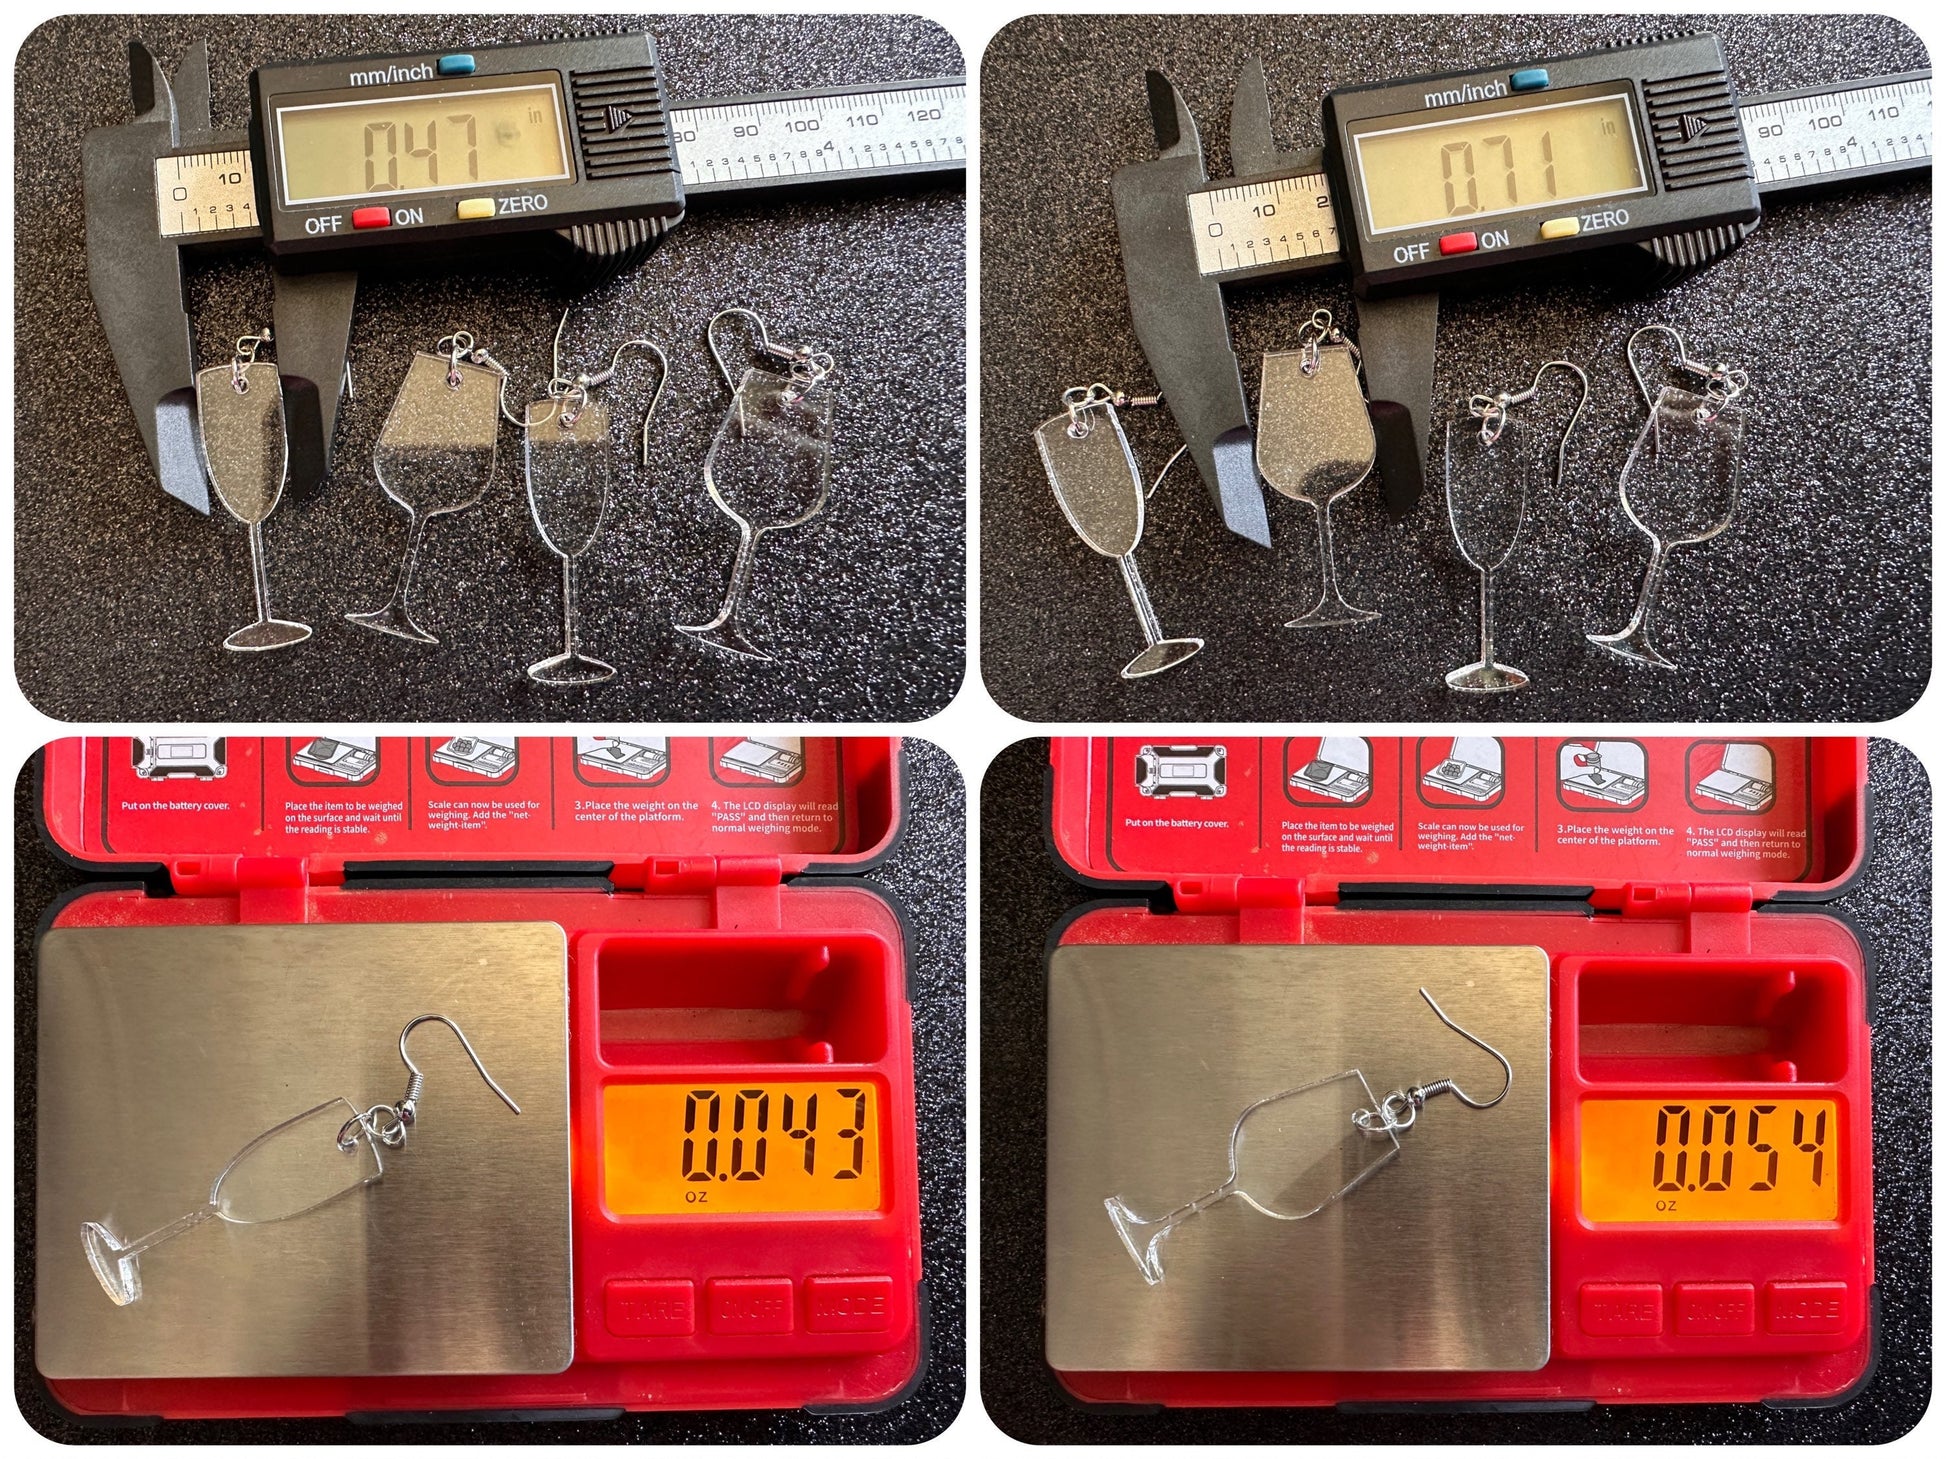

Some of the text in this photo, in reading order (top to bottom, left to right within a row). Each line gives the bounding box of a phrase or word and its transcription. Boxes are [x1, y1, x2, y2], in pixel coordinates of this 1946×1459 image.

[350, 63, 434, 86] mm/inch
[1424, 81, 1508, 108] mm/inch
[527, 107, 544, 124] in
[734, 125, 759, 138] 90
[785, 119, 819, 133] 100
[847, 114, 878, 128] 110
[907, 108, 942, 122] 120
[1601, 117, 1616, 136] in
[1758, 106, 1899, 138] 90 100 110
[364, 113, 479, 191] 0.47
[219, 173, 241, 185] 10
[1440, 130, 1557, 216] 0.71
[498, 194, 548, 215] ZERO
[1253, 204, 1276, 218] 10
[305, 208, 424, 235] OFF ON
[1581, 209, 1630, 234] ZERO
[1393, 230, 1510, 264] OFF ON
[122, 801, 230, 812] Put on the battery cover.
[285, 801, 403, 813] Place the item to be weighed
[428, 800, 540, 809] Scale can now be used for
[575, 800, 698, 812] 3.Place the weight on the
[712, 801, 838, 813] 4. The LCD display will read
[285, 813, 402, 822] on the surface and wait until
[428, 810, 530, 822] weighing. Add the "net-
[575, 812, 684, 823] center of the platform.
[712, 812, 832, 822] "PASS" and then return to
[285, 824, 370, 836] the reading is stable.
[428, 820, 487, 831] weight-item".
[712, 823, 821, 835] normal weighing mode.
[1125, 818, 1229, 830] Put on the battery cover.
[1282, 821, 1394, 833] Place the item to be weighed
[1418, 822, 1524, 832] Scale can now be used for
[1282, 832, 1393, 842] on the surface and wait until
[1418, 831, 1515, 843] weighing. Add the "net-
[1557, 825, 1674, 837] 3.Place the weight on the
[1686, 826, 1806, 839] 4. The LCD display will read
[1418, 841, 1474, 853] weight-item".
[1557, 835, 1660, 848] center of the platform.
[1687, 837, 1800, 848] "PASS" and then return to
[1281, 843, 1362, 855] the reading is stable.
[1687, 848, 1790, 860] normal weighing mode.
[682, 1088, 866, 1182] 0.043
[1653, 1105, 1826, 1192] 0.054
